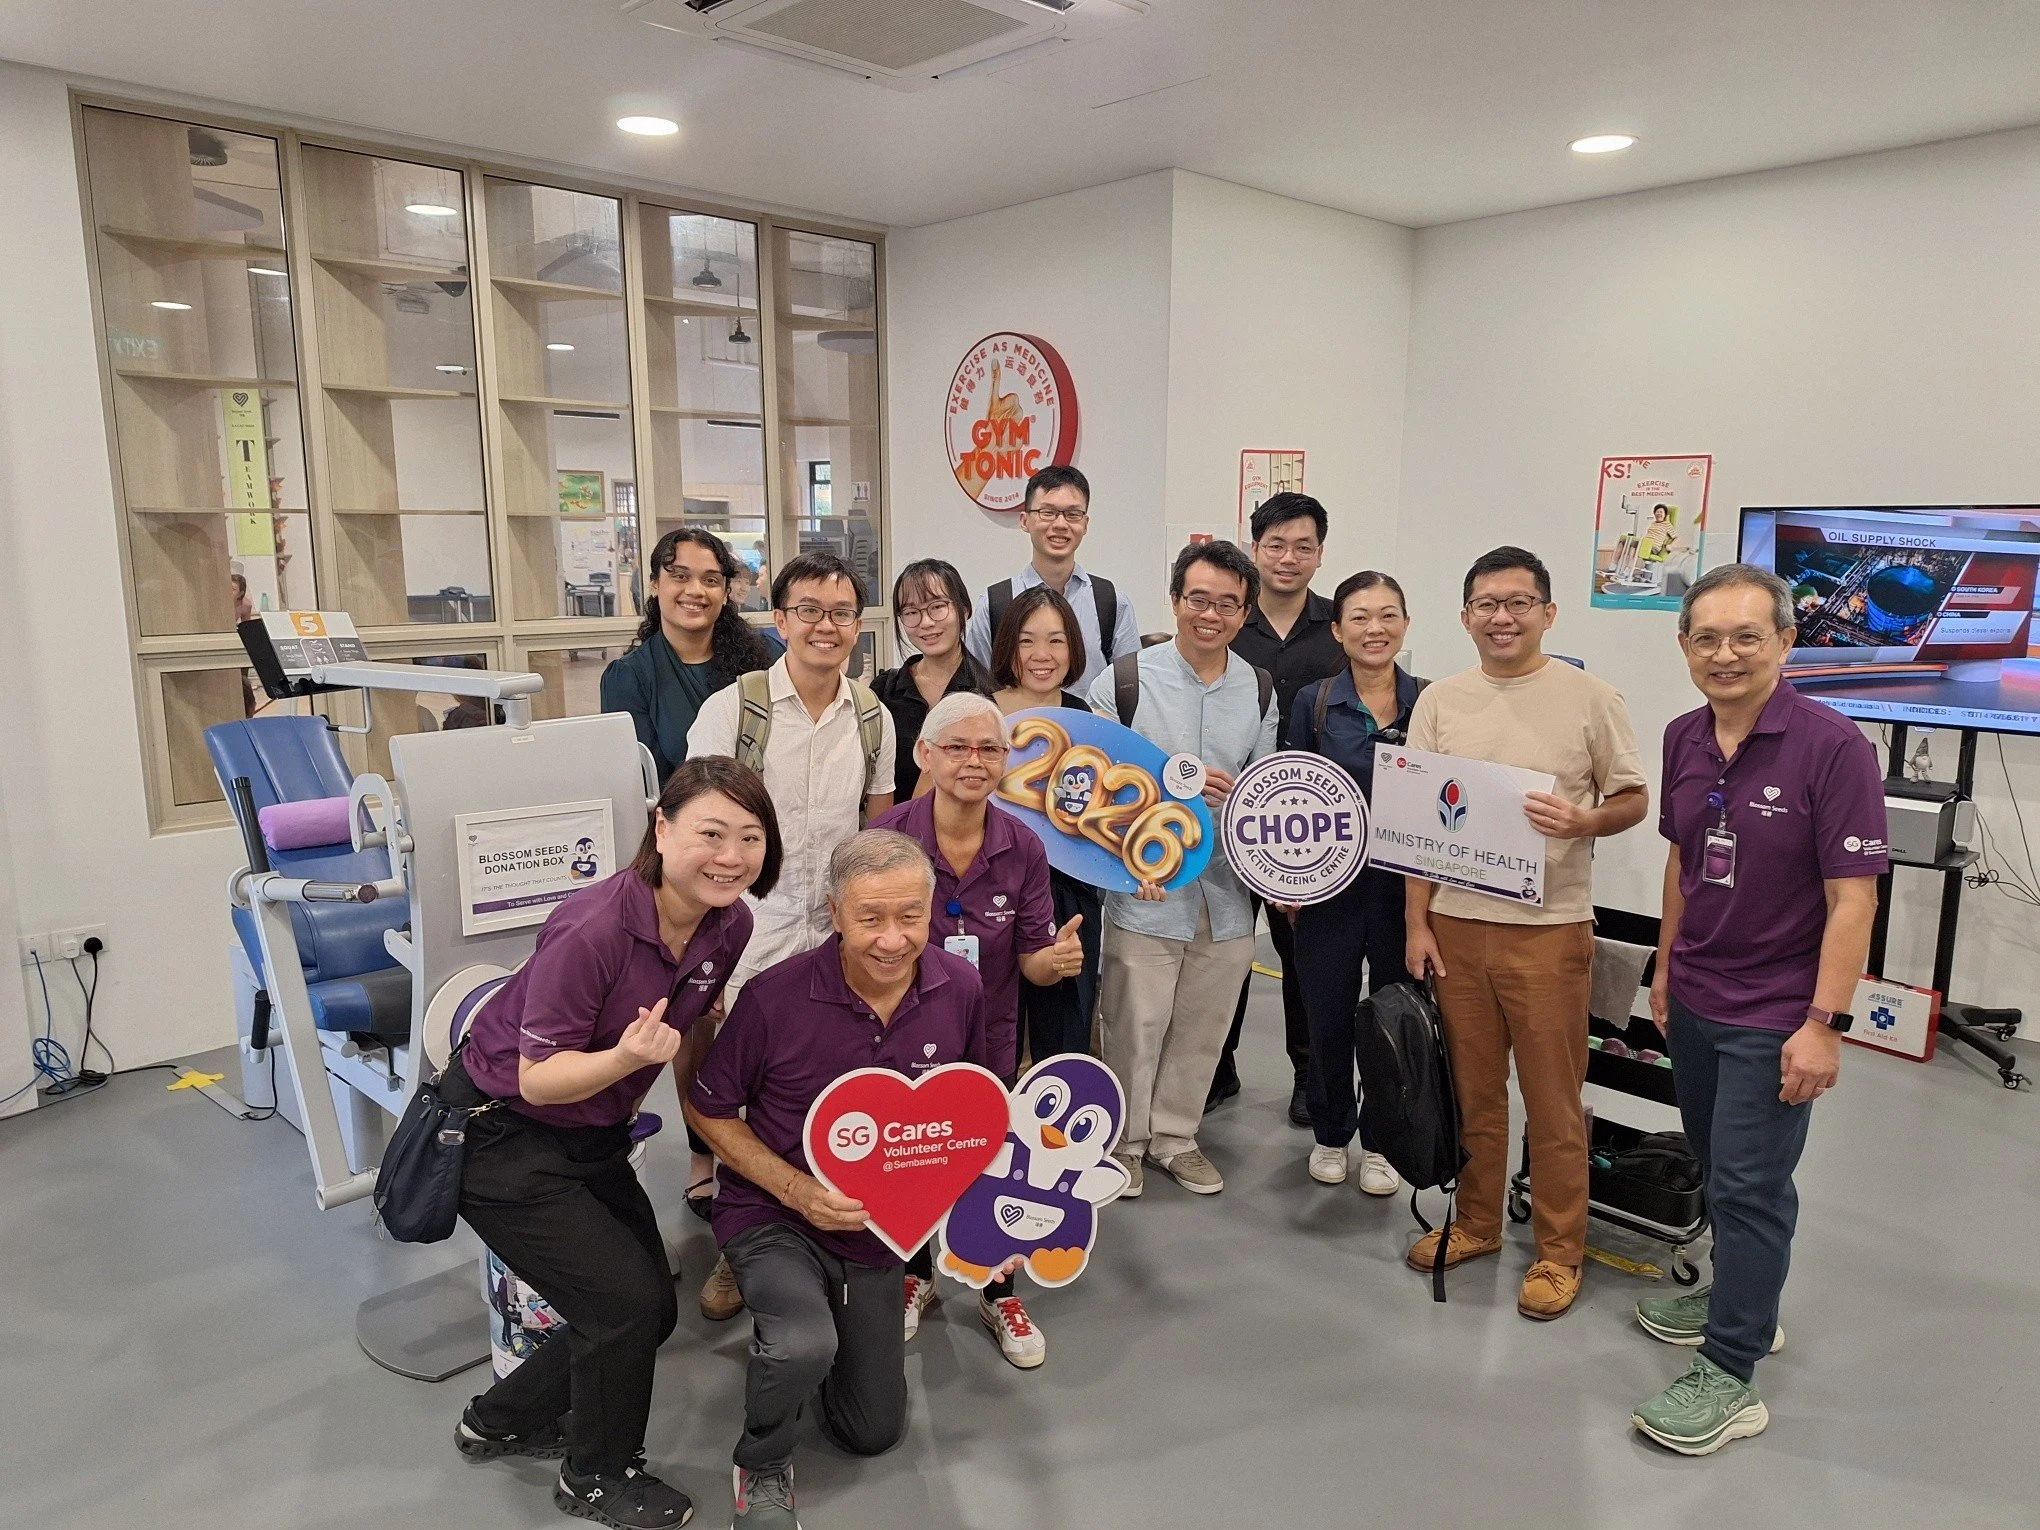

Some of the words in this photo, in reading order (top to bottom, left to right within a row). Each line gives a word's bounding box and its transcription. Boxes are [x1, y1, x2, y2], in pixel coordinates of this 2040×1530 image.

[949, 348, 987, 414] EXERCISE
[992, 342, 1008, 353] AS
[1014, 344, 1055, 406] MEDICINE
[972, 417, 1030, 448] GYM
[960, 449, 1041, 480] TONIC
[1637, 481, 1670, 489] EXERCISE
[984, 494, 1003, 503] SINCE
[1004, 492, 1019, 502] 2014
[1828, 531, 1848, 542] OIL
[1851, 533, 1896, 545] SUPPLY
[1898, 536, 1936, 548] SHOCK
[299, 616, 319, 633] 5
[1242, 767, 1301, 809] BLOSSOM
[1305, 770, 1346, 804] SEEDS
[995, 717, 1202, 885] 2026
[1771, 805, 1788, 814] Seeds
[1235, 811, 1353, 846] CHOPE
[1376, 827, 1445, 853] MINISTRY
[1448, 843, 1470, 859] OF
[1474, 849, 1537, 875] HEALTH
[1846, 840, 1859, 848] SG
[479, 849, 532, 864] BLOSSOM
[535, 844, 569, 857] SEEDS
[485, 859, 540, 875] DONATION
[543, 856, 565, 867] BOX
[1246, 848, 1276, 878] ACTIVE
[1278, 874, 1317, 885] AGEING
[1320, 846, 1350, 878] CENTRE
[1415, 854, 1487, 881] SINGAPORE
[505, 880, 531, 889] THOUGHT
[545, 875, 567, 883] COUNTS
[515, 899, 532, 907] Serve
[1868, 993, 1904, 1006] ASSURE
[1863, 1028, 1876, 1037] First
[1876, 1032, 1889, 1040] Aid
[836, 1126, 870, 1148] SG
[883, 1119, 953, 1144] Cares
[883, 1140, 943, 1159] Volunteer
[947, 1137, 988, 1151] Centre
[883, 1155, 949, 1173] @Sembawang
